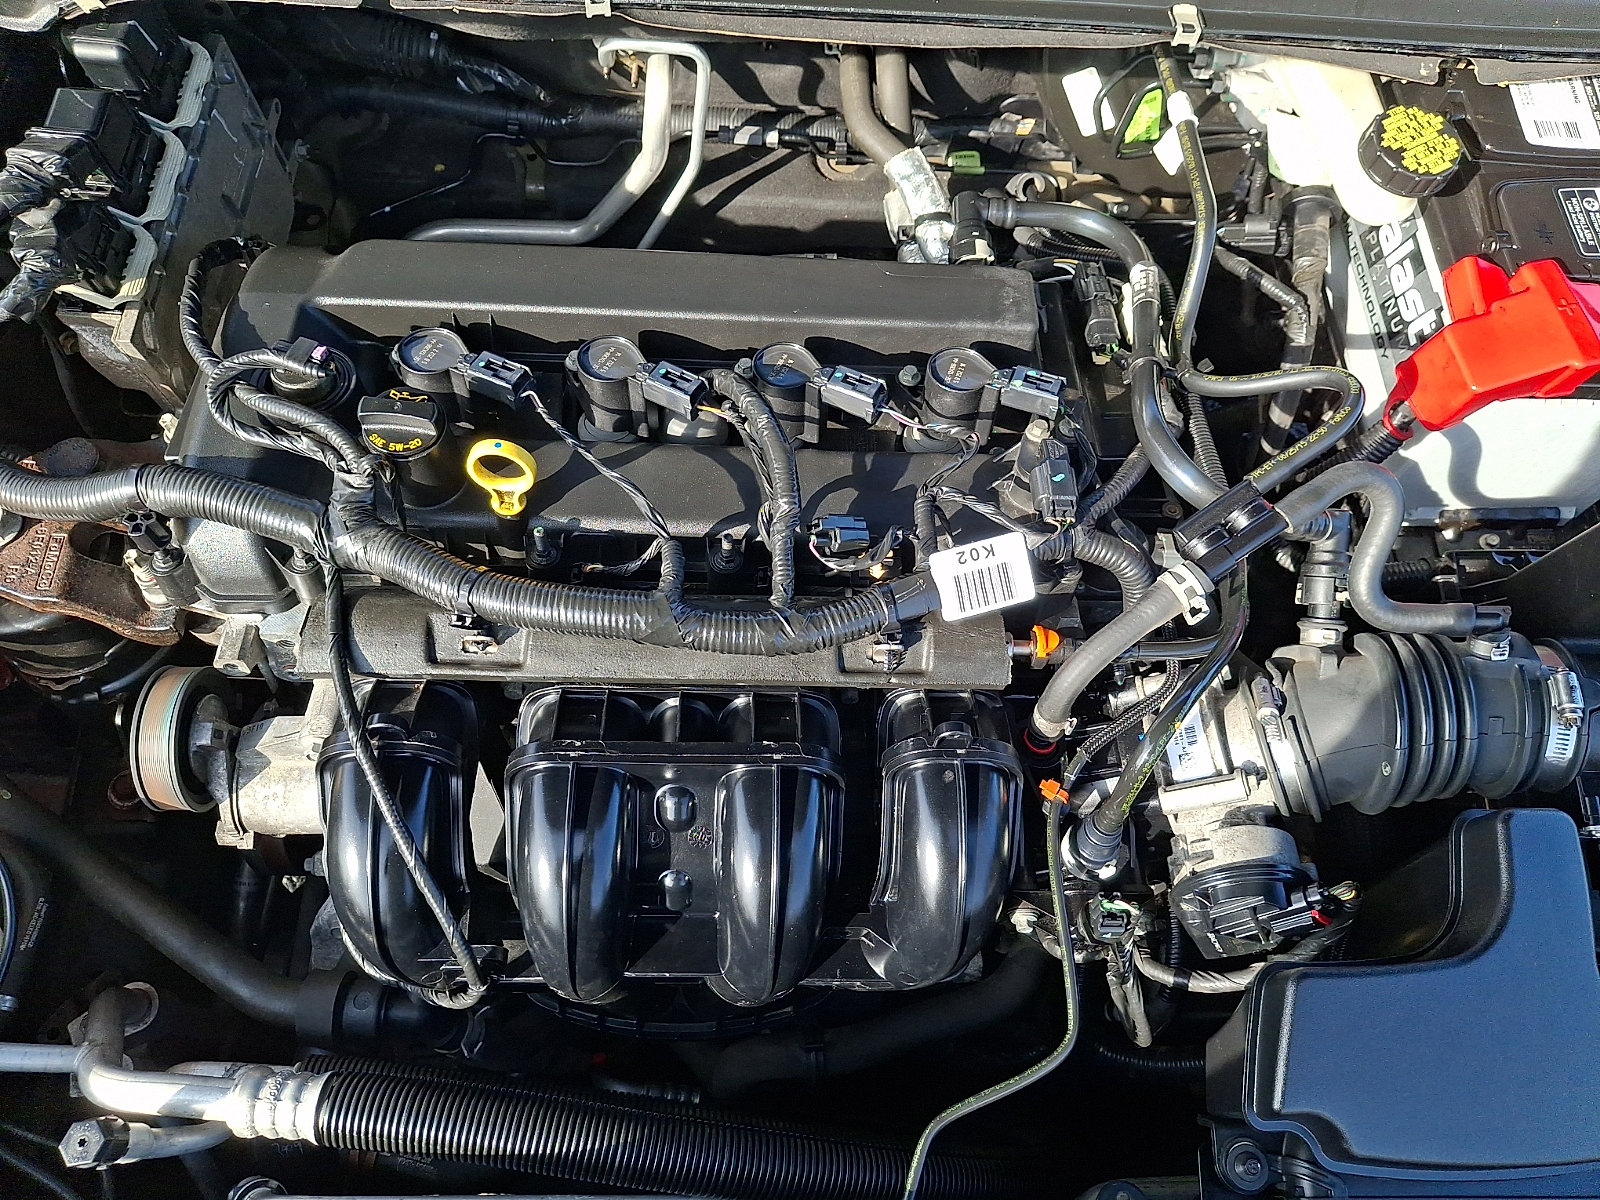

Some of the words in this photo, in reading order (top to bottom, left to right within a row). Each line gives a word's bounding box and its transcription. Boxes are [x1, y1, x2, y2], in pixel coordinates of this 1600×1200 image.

[1350, 241, 1389, 359] TECHNOLOGY
[1365, 230, 1410, 354] PLATINUM
[1378, 221, 1437, 347] alast
[368, 433, 387, 448] SAE
[388, 438, 422, 451] 5W-20
